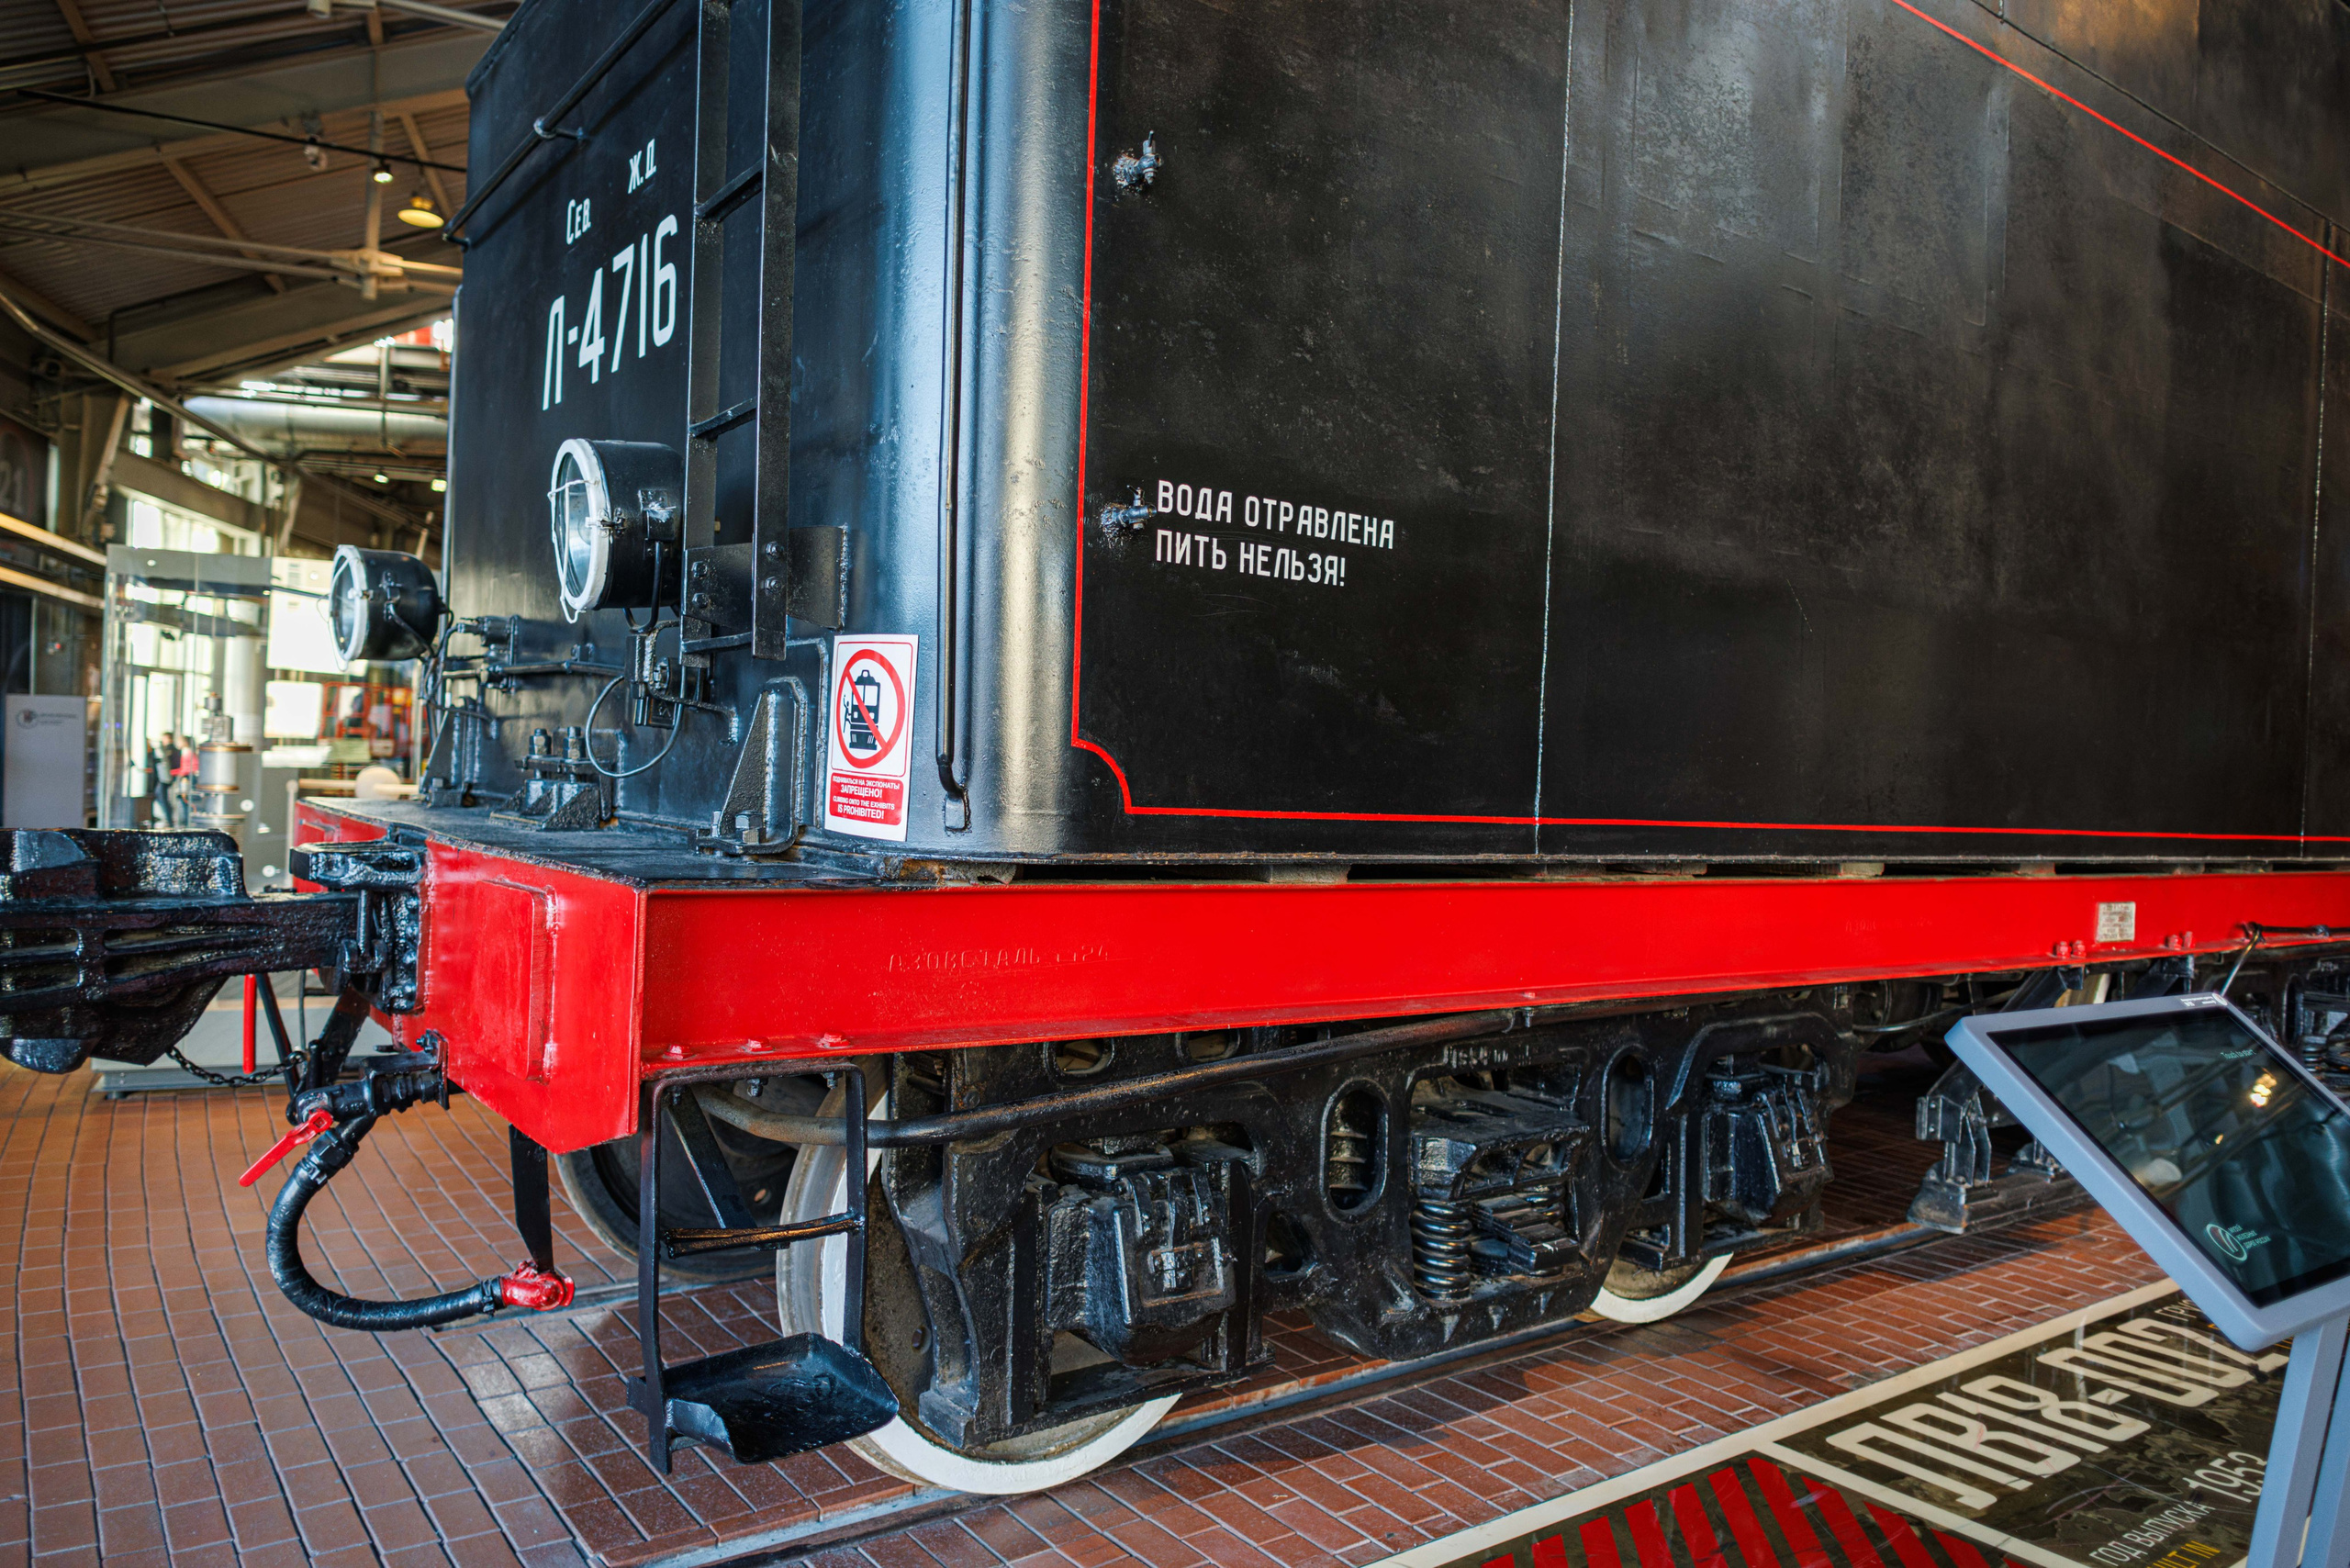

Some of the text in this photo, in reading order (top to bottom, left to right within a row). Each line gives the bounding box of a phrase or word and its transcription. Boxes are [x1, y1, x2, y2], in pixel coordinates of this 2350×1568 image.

[543, 214, 677, 411] Л-4716
[1157, 479, 1395, 550] ВОДА ОТРАВЛЕНА
[1156, 529, 1346, 588] ПИТЬ НЕЛЬЗЯ!
[841, 785, 883, 798] ЗАПРЕЩЕНО!
[866, 780, 900, 790] ЭКСПОНАТЫ
[837, 804, 884, 819] IS PROHIBITED!
[849, 798, 860, 806] ONTO
[871, 801, 895, 810] EXHIBITS
[2088, 1540, 2149, 1567] ГОД
[2122, 1500, 2216, 1548] ВЫПУСКА
